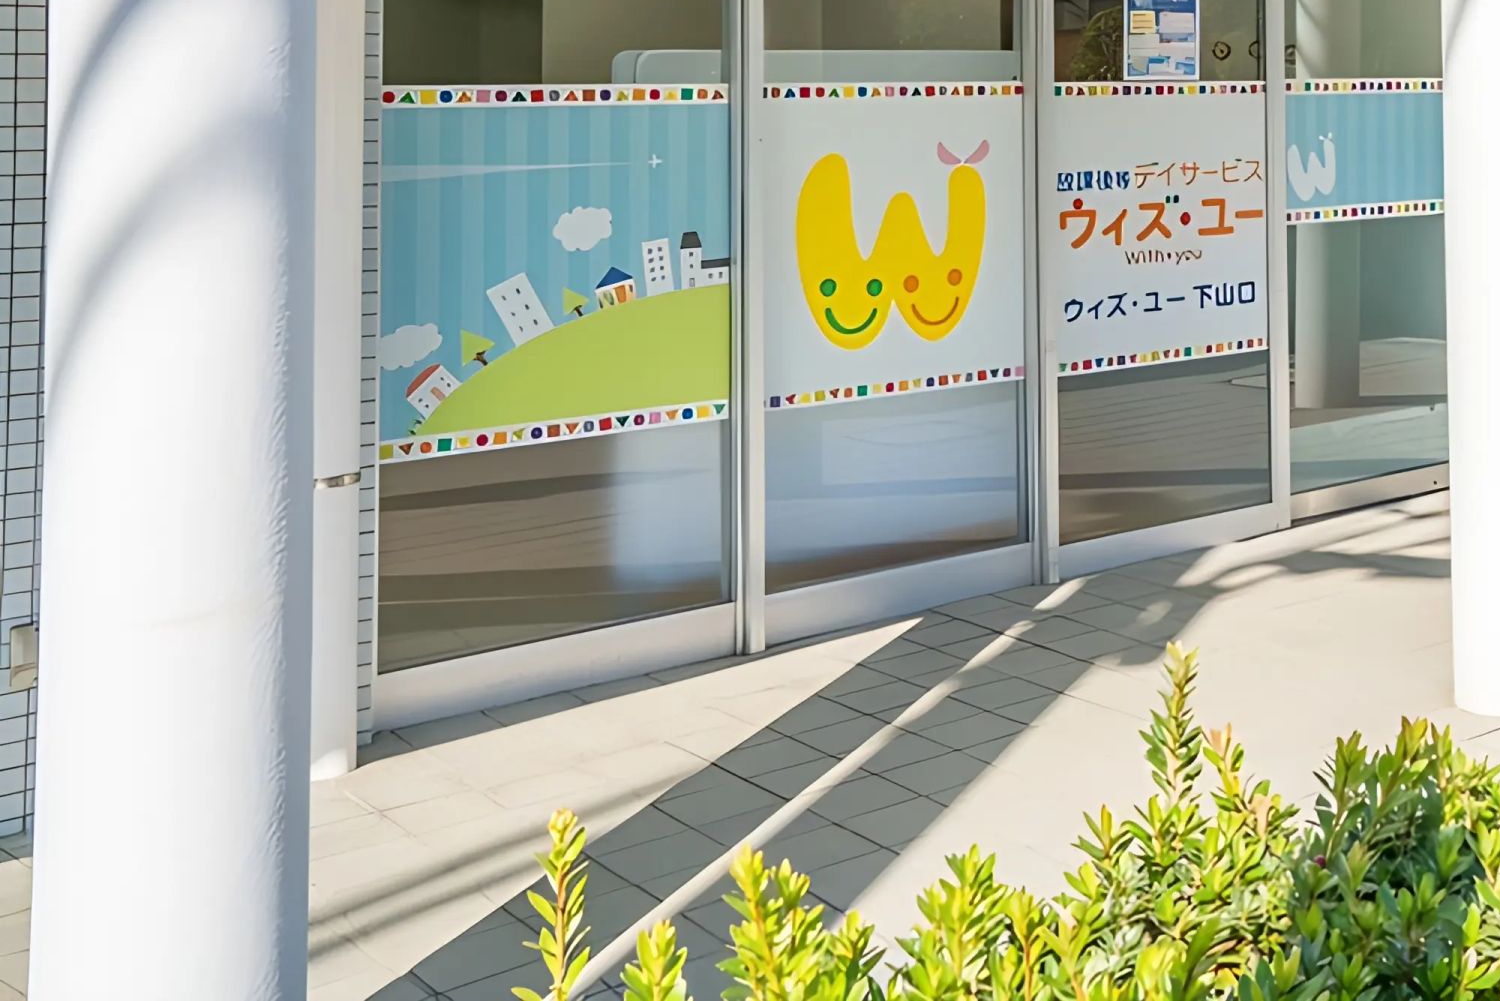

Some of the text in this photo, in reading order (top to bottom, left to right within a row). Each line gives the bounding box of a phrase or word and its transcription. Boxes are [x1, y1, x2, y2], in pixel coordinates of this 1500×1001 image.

[1059, 194, 1264, 249] ウィズ・ユー
